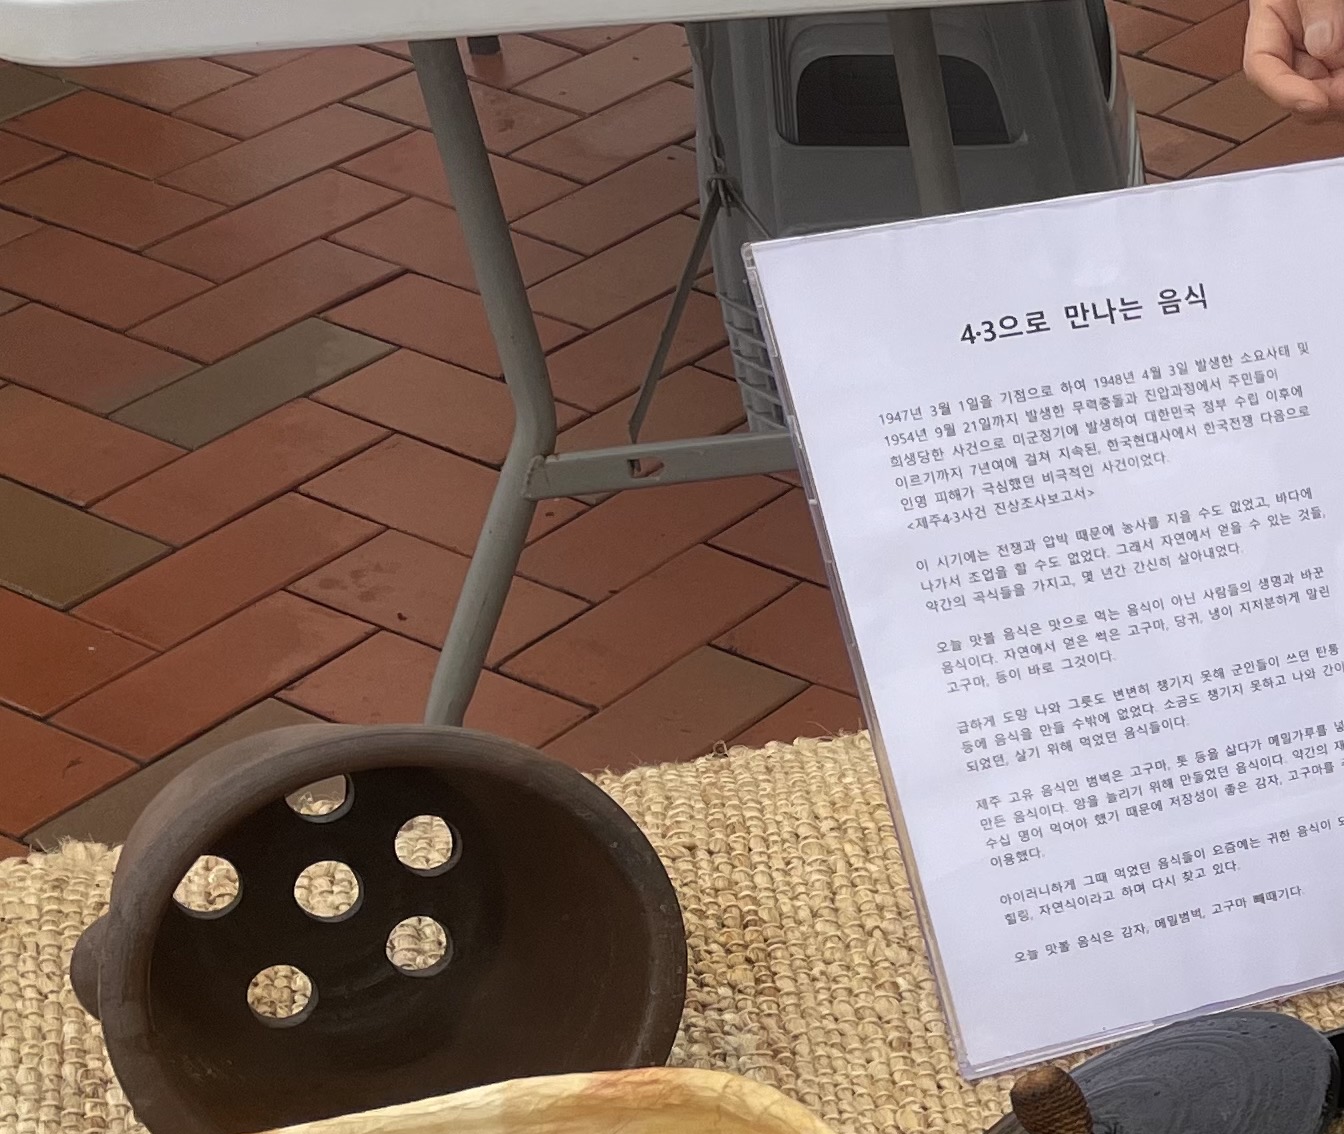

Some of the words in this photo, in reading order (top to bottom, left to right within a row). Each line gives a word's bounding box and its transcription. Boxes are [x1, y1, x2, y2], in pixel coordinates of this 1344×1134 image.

[1062, 296, 1144, 330] 만나는
[1156, 281, 1208, 316] 음식
[877, 404, 924, 426] 1947년
[928, 400, 952, 418] 3월
[957, 393, 993, 412] 1일을
[998, 383, 1054, 405] 기점으로
[1058, 376, 1087, 395] 하여
[1092, 369, 1136, 389] 1948년
[1140, 364, 1162, 381] 4월
[1167, 359, 1189, 377] 3일
[1193, 352, 1234, 373] 발생한
[1239, 343, 1291, 365] 소요사태
[883, 426, 929, 447] 1954년
[933, 421, 957, 439] 9월
[961, 410, 1019, 434] 21일까지
[1023, 402, 1065, 424] 발생한
[1143, 375, 1222, 403] 진압과정에서
[1227, 367, 1279, 388] 주민들이
[889, 446, 945, 468] 희생당한
[951, 436, 1007, 458] 사건으로
[1011, 422, 1079, 447] 미군정기에
[1083, 412, 1138, 435] 발생하여
[1142, 402, 1196, 423] 대한민국
[1200, 396, 1227, 414] 정부
[1233, 390, 1260, 409] 수립
[1264, 383, 1304, 403] 이후에
[894, 464, 964, 490] 이르기까지
[968, 454, 1019, 476] 7년여에
[1023, 448, 1052, 467] 걸쳐
[1105, 422, 1198, 453] 한국현대사에서
[1201, 412, 1254, 435] 한국전쟁
[1258, 404, 1311, 424] 다음으로
[899, 492, 928, 512] 인명
[933, 484, 975, 505] 피해가
[980, 473, 1035, 496] 극심했던
[914, 557, 929, 572] 이
[936, 548, 990, 569] 시기에는
[994, 537, 1037, 558] 전쟁과
[1041, 531, 1069, 549] 압박
[1074, 522, 1116, 542] 때문에
[1197, 503, 1225, 520] 수도
[1274, 485, 1313, 505] 바다에
[919, 572, 962, 593] 나가서
[967, 564, 1008, 584] 조업을
[1033, 554, 1062, 572] 수도
[1115, 536, 1155, 555] 그래서
[1159, 525, 1212, 547] 자연에서
[1247, 517, 1261, 531] 수
[1266, 511, 1292, 528] 있는
[1099, 562, 1127, 581] 년간
[1131, 554, 1172, 575] 간신히
[935, 638, 963, 654] 오늘
[1001, 621, 1043, 641] 음식은
[1046, 612, 1089, 633] 맛으로
[1092, 607, 1121, 622] 먹는
[1125, 596, 1165, 618] 음식이
[1169, 590, 1196, 608] 아닌
[1201, 578, 1253, 601] 사람들의
[1257, 570, 1295, 591] 생명과
[1299, 565, 1325, 581] 바꾼
[1002, 638, 1057, 661] 자연에서
[1061, 633, 1089, 651] 얻은
[1206, 603, 1233, 621] 냉이
[1238, 589, 1301, 614] 지저분하게
[993, 726, 1033, 747] 음식을
[1038, 719, 1065, 737] 만들
[1071, 710, 1111, 731] 수밖에
[1162, 691, 1202, 711] 소금도
[1248, 673, 1287, 693] 못하고
[1290, 666, 1316, 683] 나와
[994, 666, 1022, 685] 등이
[1026, 660, 1055, 676] 바로
[1001, 706, 1028, 724] 도망
[1033, 700, 1061, 717] 나와
[1229, 654, 1280, 677] 군인들이
[1285, 648, 1310, 665] 쓰던
[1013, 744, 1041, 763] 살기
[1046, 738, 1074, 756] 위해
[1077, 729, 1118, 749] 먹었던
[974, 794, 1002, 811] 제주
[1007, 787, 1035, 804] 고유
[1040, 777, 1080, 798] 음식인
[1084, 768, 1124, 788] 범벅은
[978, 813, 1007, 832] 만든
[1148, 776, 1175, 794] 위해
[1178, 764, 1230, 787] 만들었던
[984, 832, 1011, 850] 수십
[1048, 815, 1088, 835] 먹어야
[1092, 808, 1120, 827] 했기
[1124, 798, 1164, 818] 때문에
[1167, 785, 1219, 808] 저장성이
[998, 877, 1077, 906] 아이러니하게
[1082, 870, 1109, 887] 그때
[1112, 860, 1152, 880] 먹었던
[1156, 846, 1206, 871] 음식들이
[1265, 827, 1291, 845] 귀한
[1295, 817, 1332, 838] 음식이
[1037, 889, 1116, 916] 자연식이라고
[1120, 880, 1147, 898] 하며
[1150, 873, 1177, 890] 다시
[1013, 948, 1039, 963] 오늘
[1076, 929, 1115, 949] 음식은
[1210, 895, 1248, 915] 고구마
